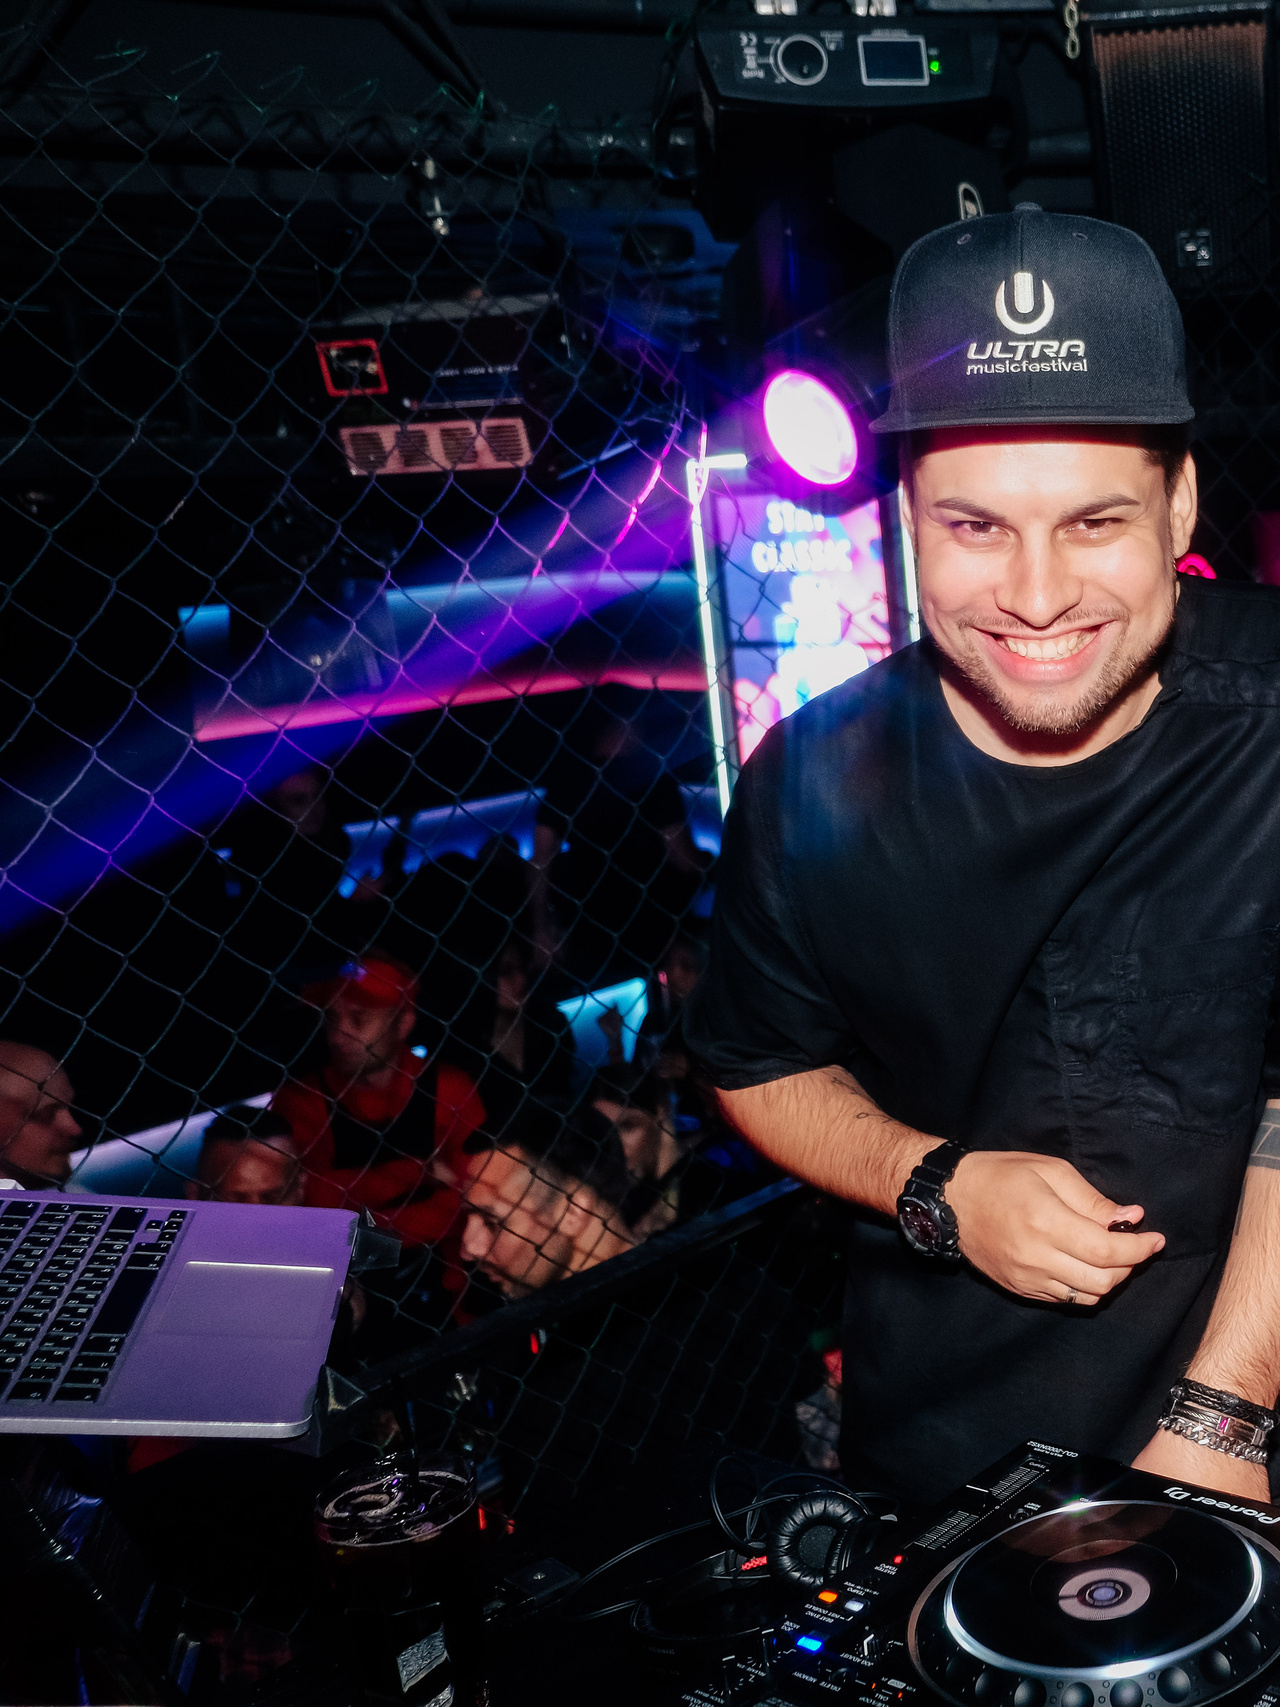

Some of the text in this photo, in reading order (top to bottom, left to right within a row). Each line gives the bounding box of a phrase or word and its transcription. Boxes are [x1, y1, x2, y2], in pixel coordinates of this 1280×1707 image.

[966, 339, 1087, 361] ULTRA
[966, 358, 1087, 376] musicfestival
[1162, 1486, 1192, 1501] DJ
